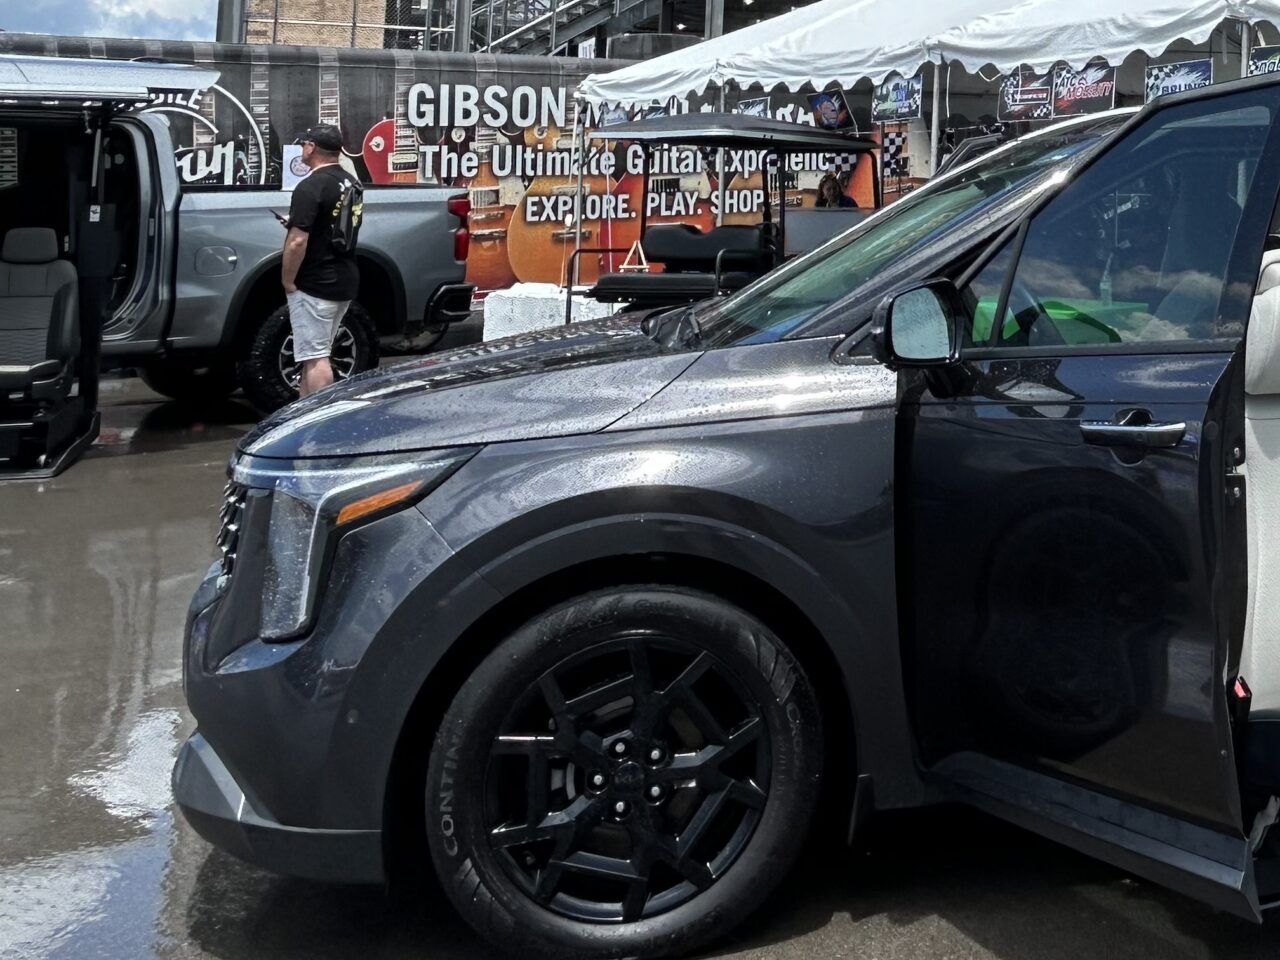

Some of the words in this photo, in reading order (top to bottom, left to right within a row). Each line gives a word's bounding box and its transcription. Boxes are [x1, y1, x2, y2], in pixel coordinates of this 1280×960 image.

[407, 82, 567, 129] GIBSON
[419, 144, 479, 179] The
[491, 143, 616, 178] Ultimate
[646, 190, 702, 217] PLAY.
